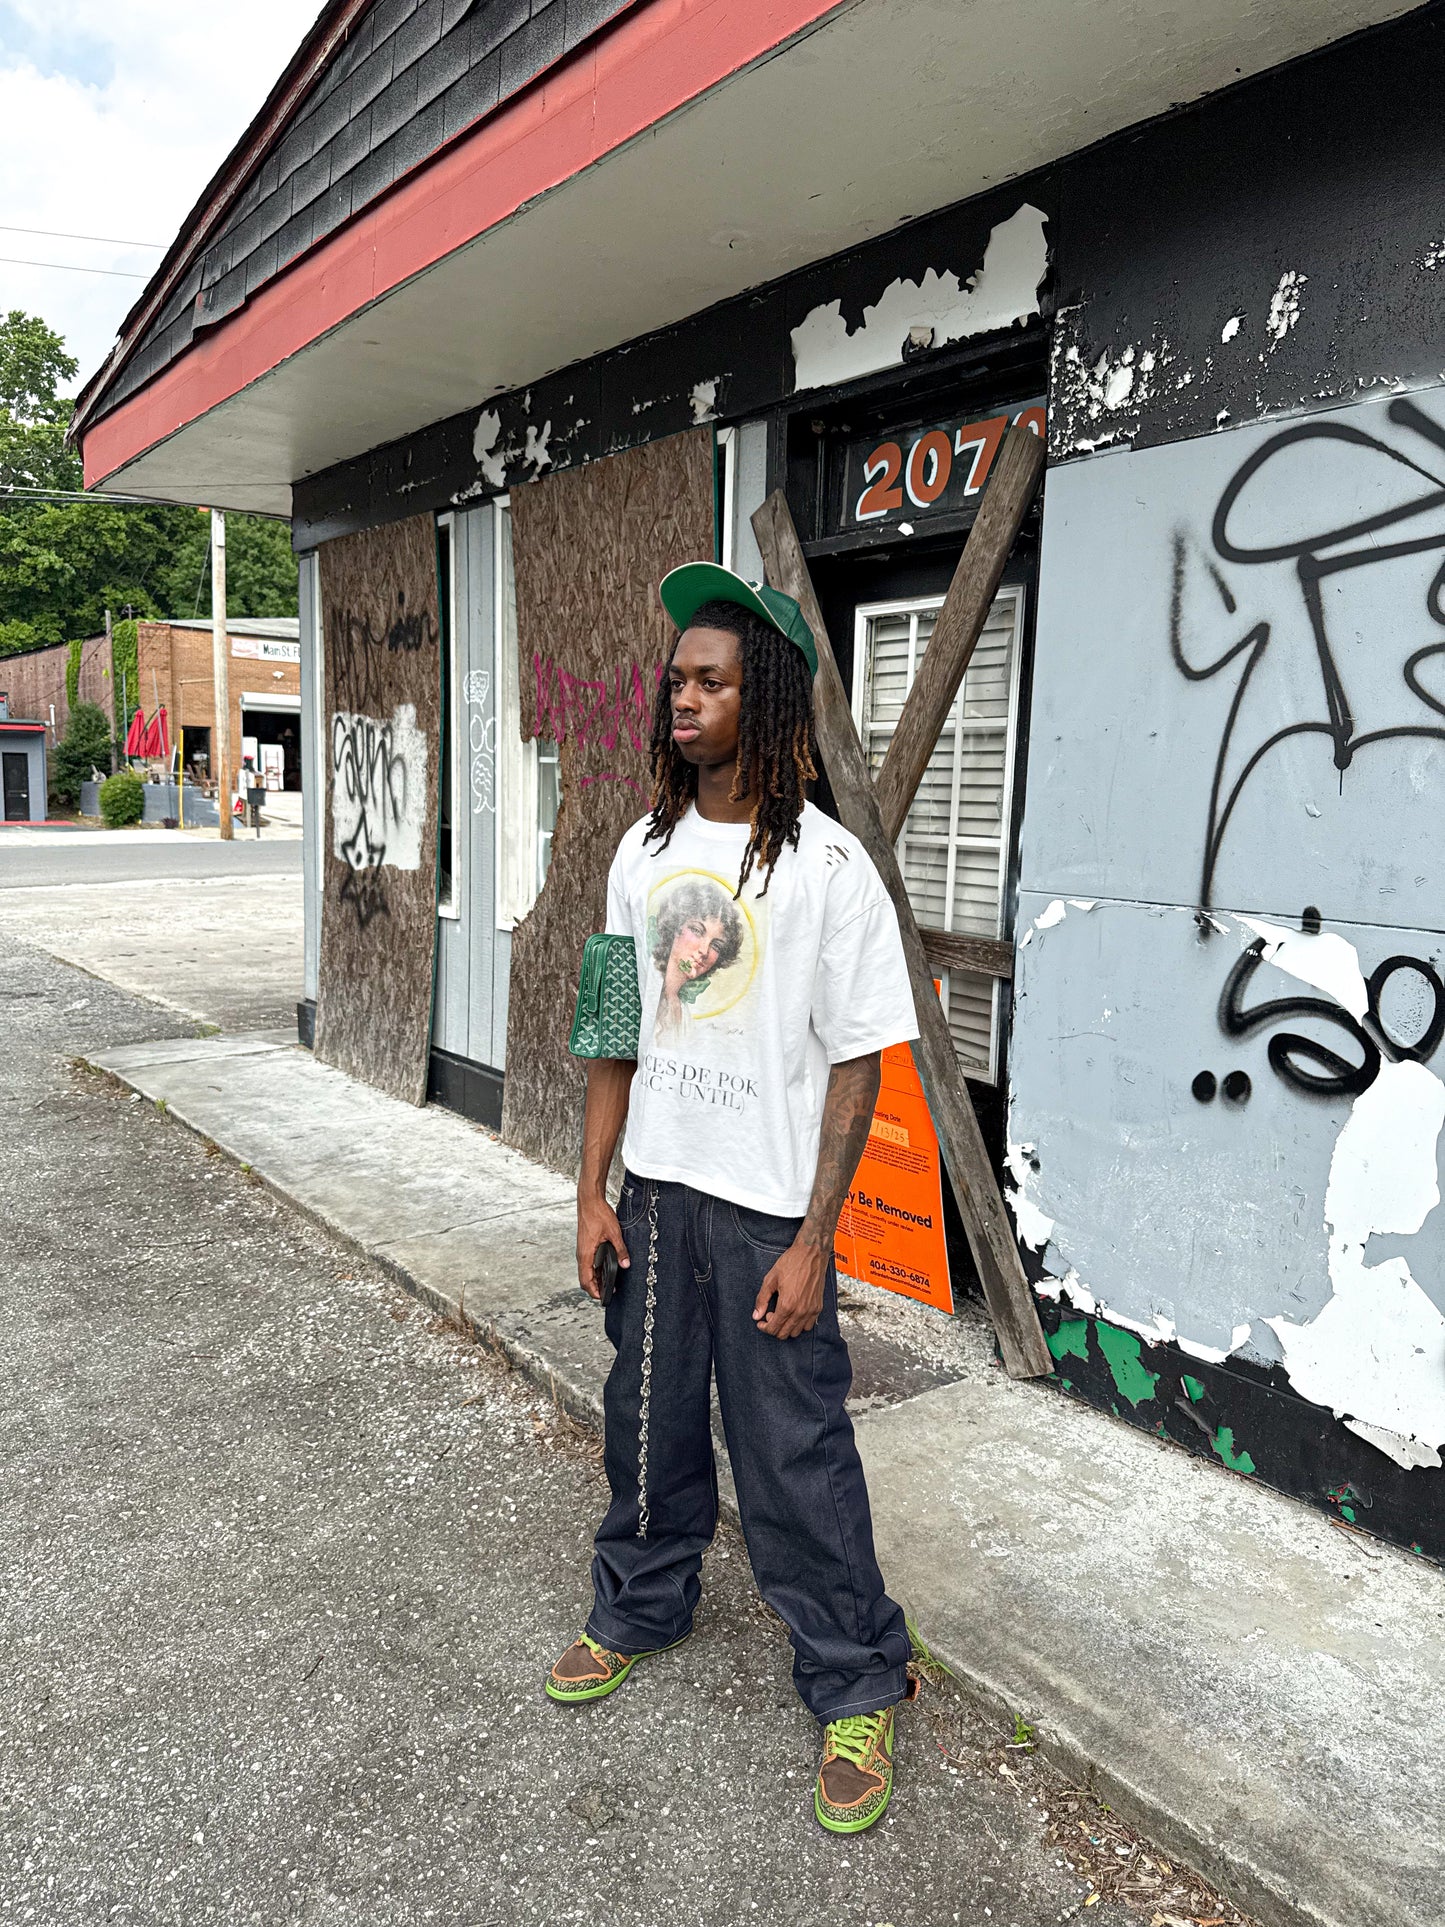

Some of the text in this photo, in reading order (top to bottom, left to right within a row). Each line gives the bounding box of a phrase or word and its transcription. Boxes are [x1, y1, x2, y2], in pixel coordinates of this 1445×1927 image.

[263, 643, 281, 656] Main
[681, 1063, 711, 1085] DE
[718, 1072, 759, 1098] POK
[889, 1114, 902, 1123] Date
[845, 1190, 856, 1204] y
[858, 1191, 872, 1208] Be
[875, 1197, 932, 1229] Removed
[869, 1260, 930, 1287] 404-330-6874
